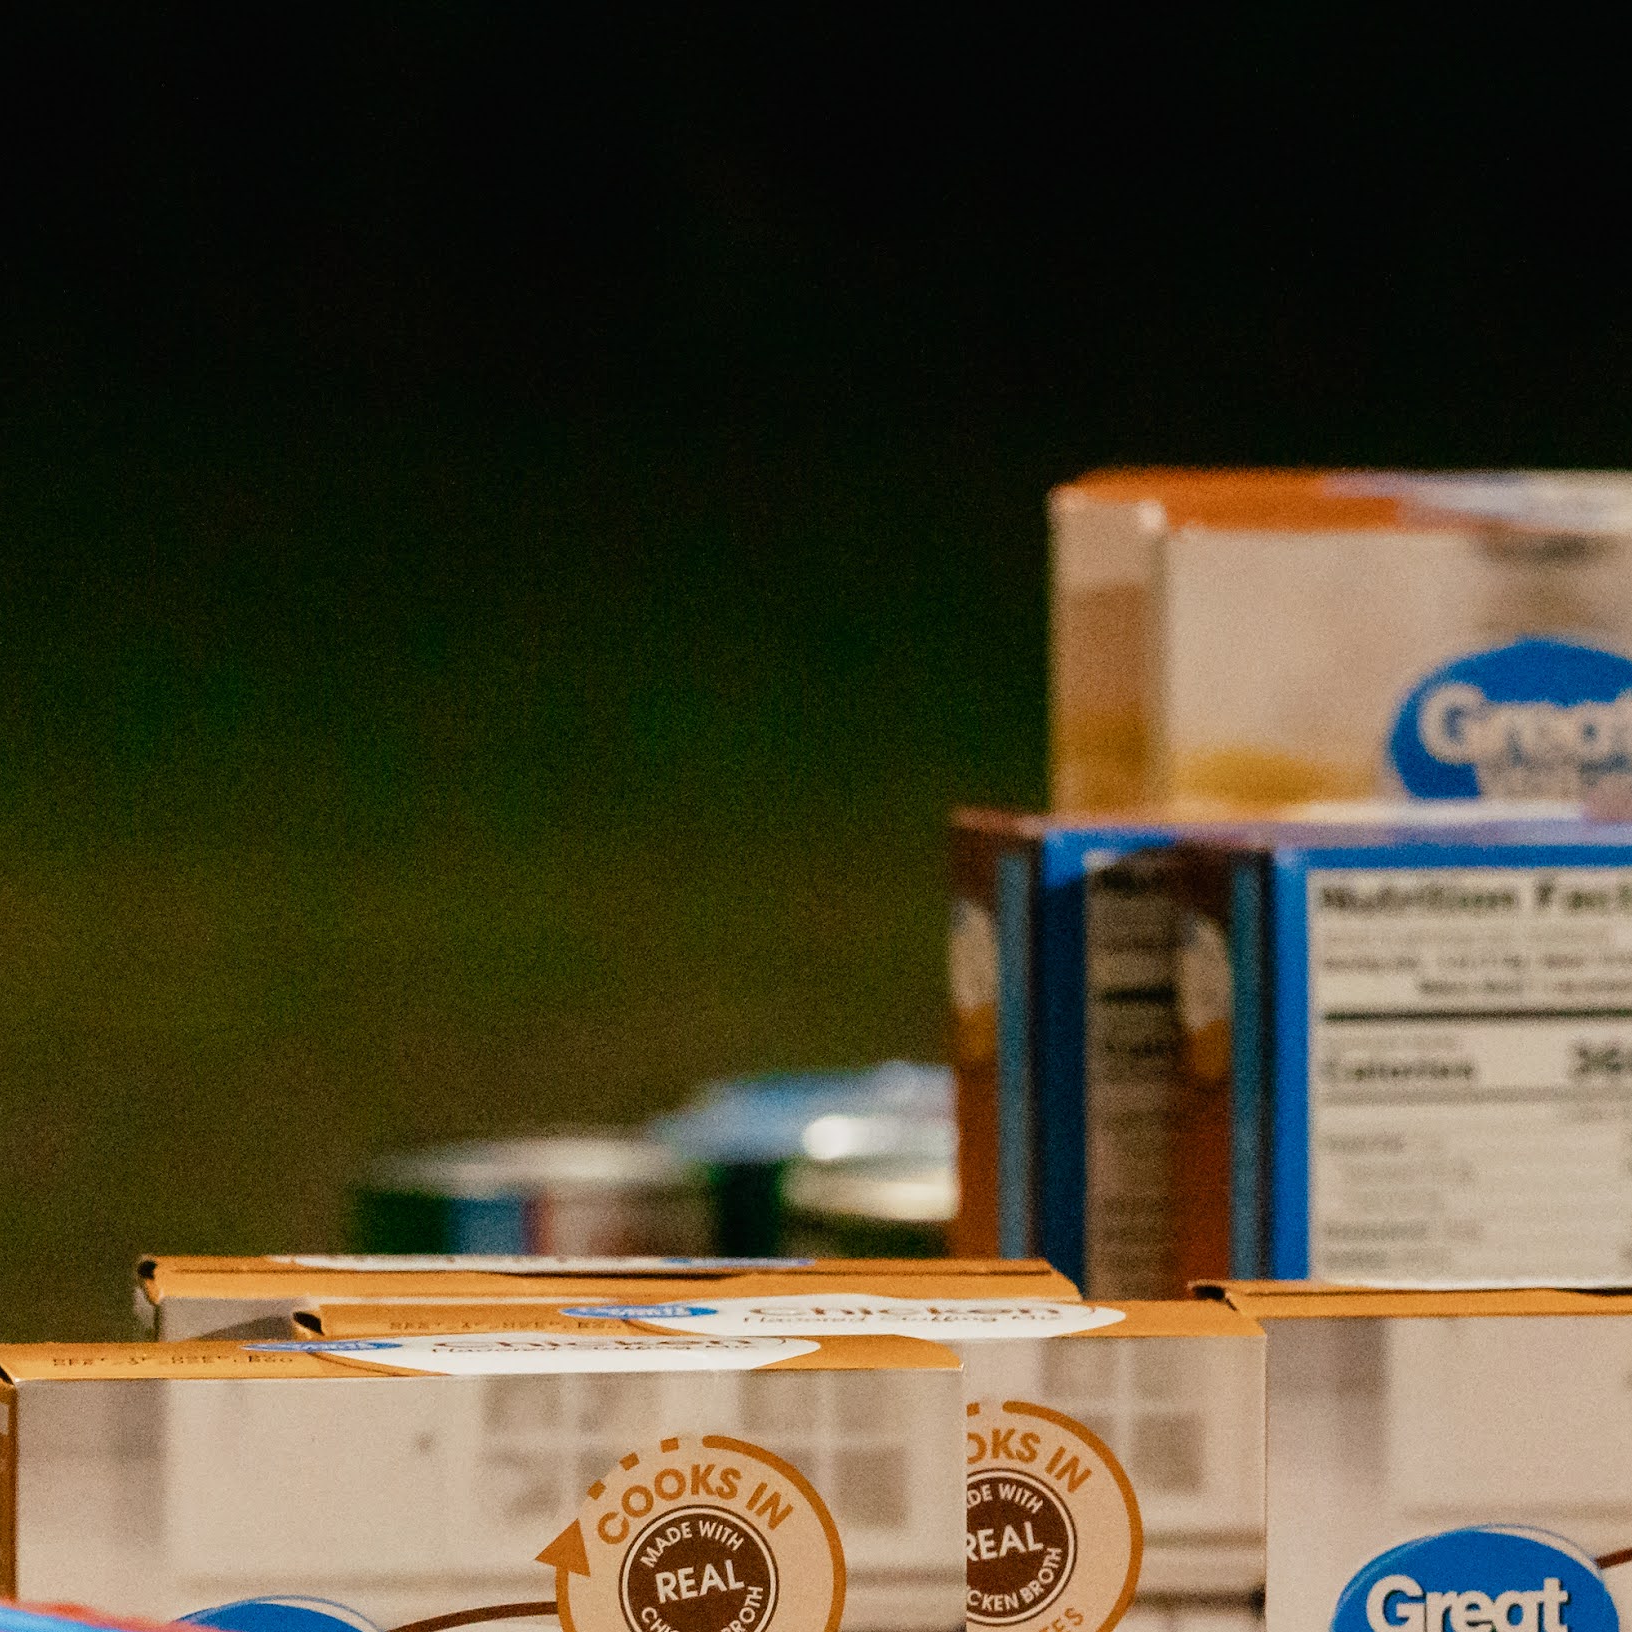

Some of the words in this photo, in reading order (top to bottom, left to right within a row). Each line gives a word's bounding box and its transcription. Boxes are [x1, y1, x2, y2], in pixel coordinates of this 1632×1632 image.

[1045, 1446, 1092, 1494] IN
[596, 1463, 742, 1545] COOKS
[746, 1481, 794, 1531] IN
[967, 1483, 993, 1509] DE
[999, 1482, 1044, 1514] WITH
[640, 1521, 692, 1568] MADE
[699, 1520, 744, 1551] WITH
[655, 1559, 745, 1604] REAL
[967, 1586, 1019, 1612] CKEN
[1021, 1547, 1063, 1604] BROTH
